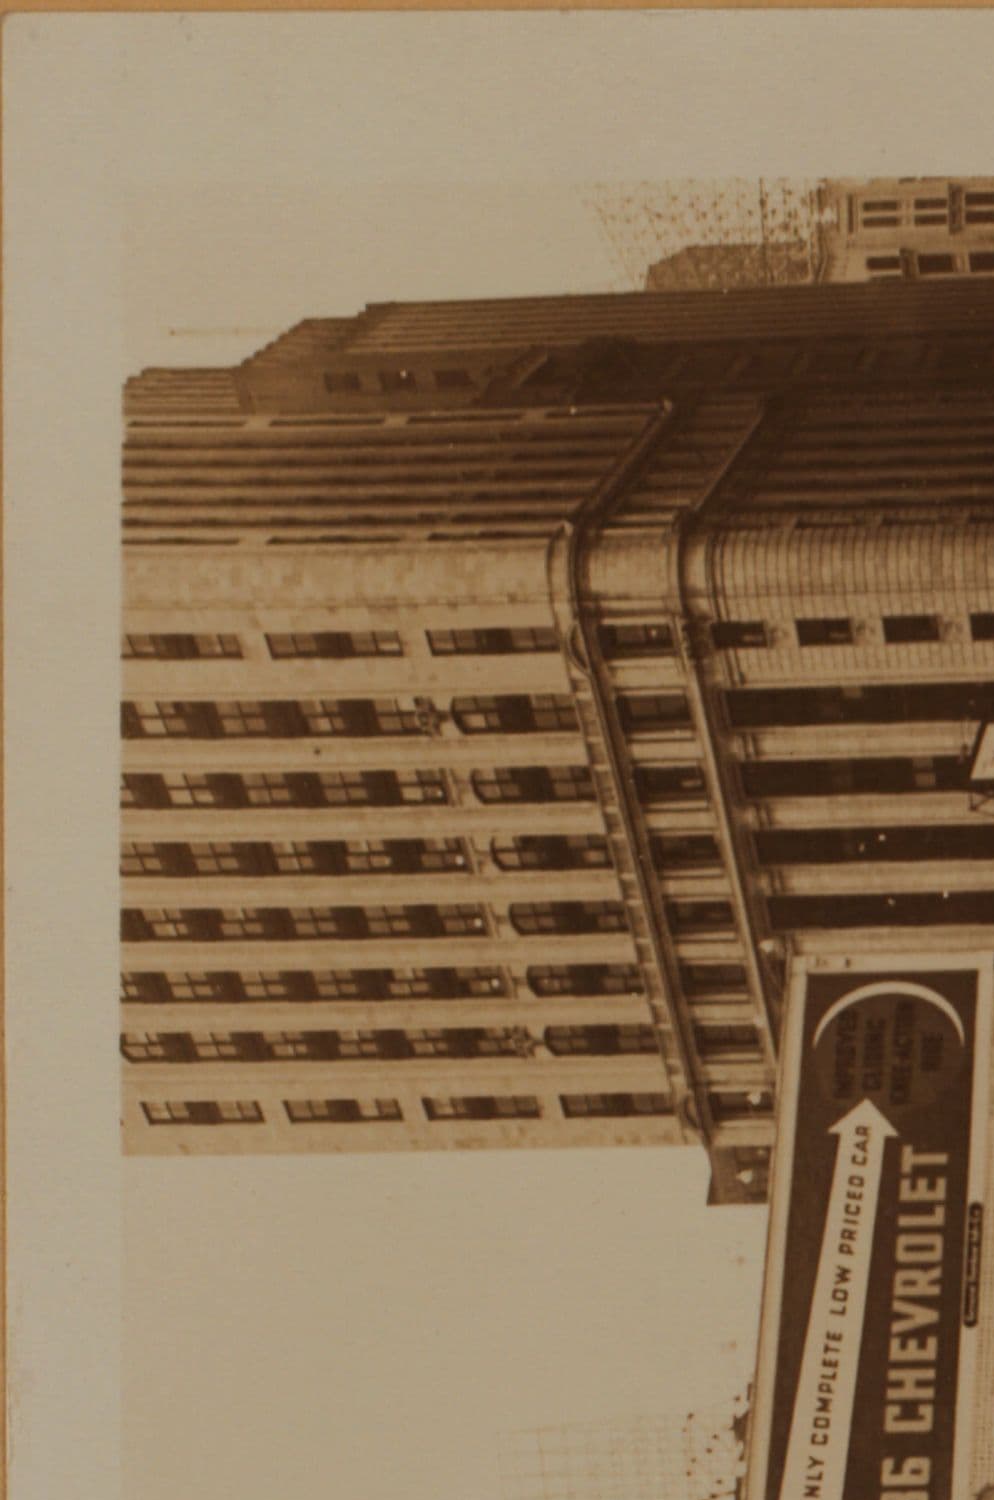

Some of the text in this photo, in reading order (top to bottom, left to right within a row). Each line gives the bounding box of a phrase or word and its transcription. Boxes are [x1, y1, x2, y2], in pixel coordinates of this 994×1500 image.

[850, 1124, 874, 1168] CAR
[837, 1173, 866, 1257] PRICED
[828, 1265, 852, 1317] LOW
[883, 1143, 950, 1435] CHEVROLET
[810, 1331, 844, 1447] COMPLETE
